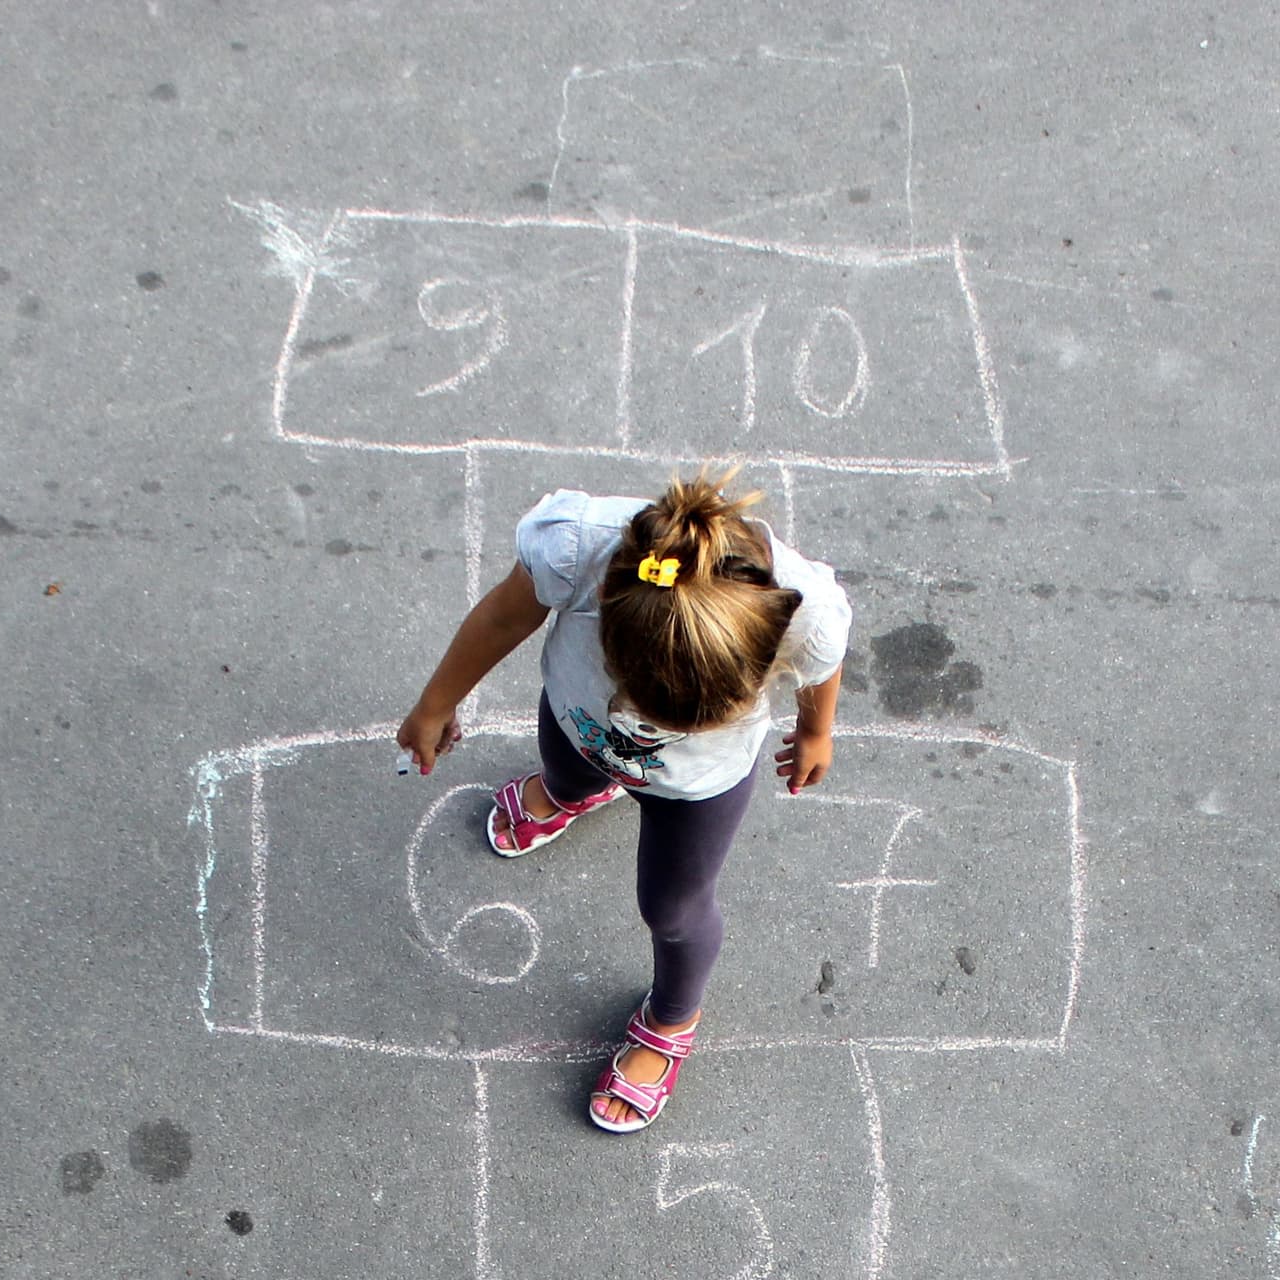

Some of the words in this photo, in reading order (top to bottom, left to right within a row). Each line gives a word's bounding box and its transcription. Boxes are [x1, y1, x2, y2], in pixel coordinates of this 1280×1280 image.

[416, 277, 510, 398] 9
[692, 301, 871, 435] 10
[405, 781, 543, 985] 6
[775, 791, 938, 969] 7
